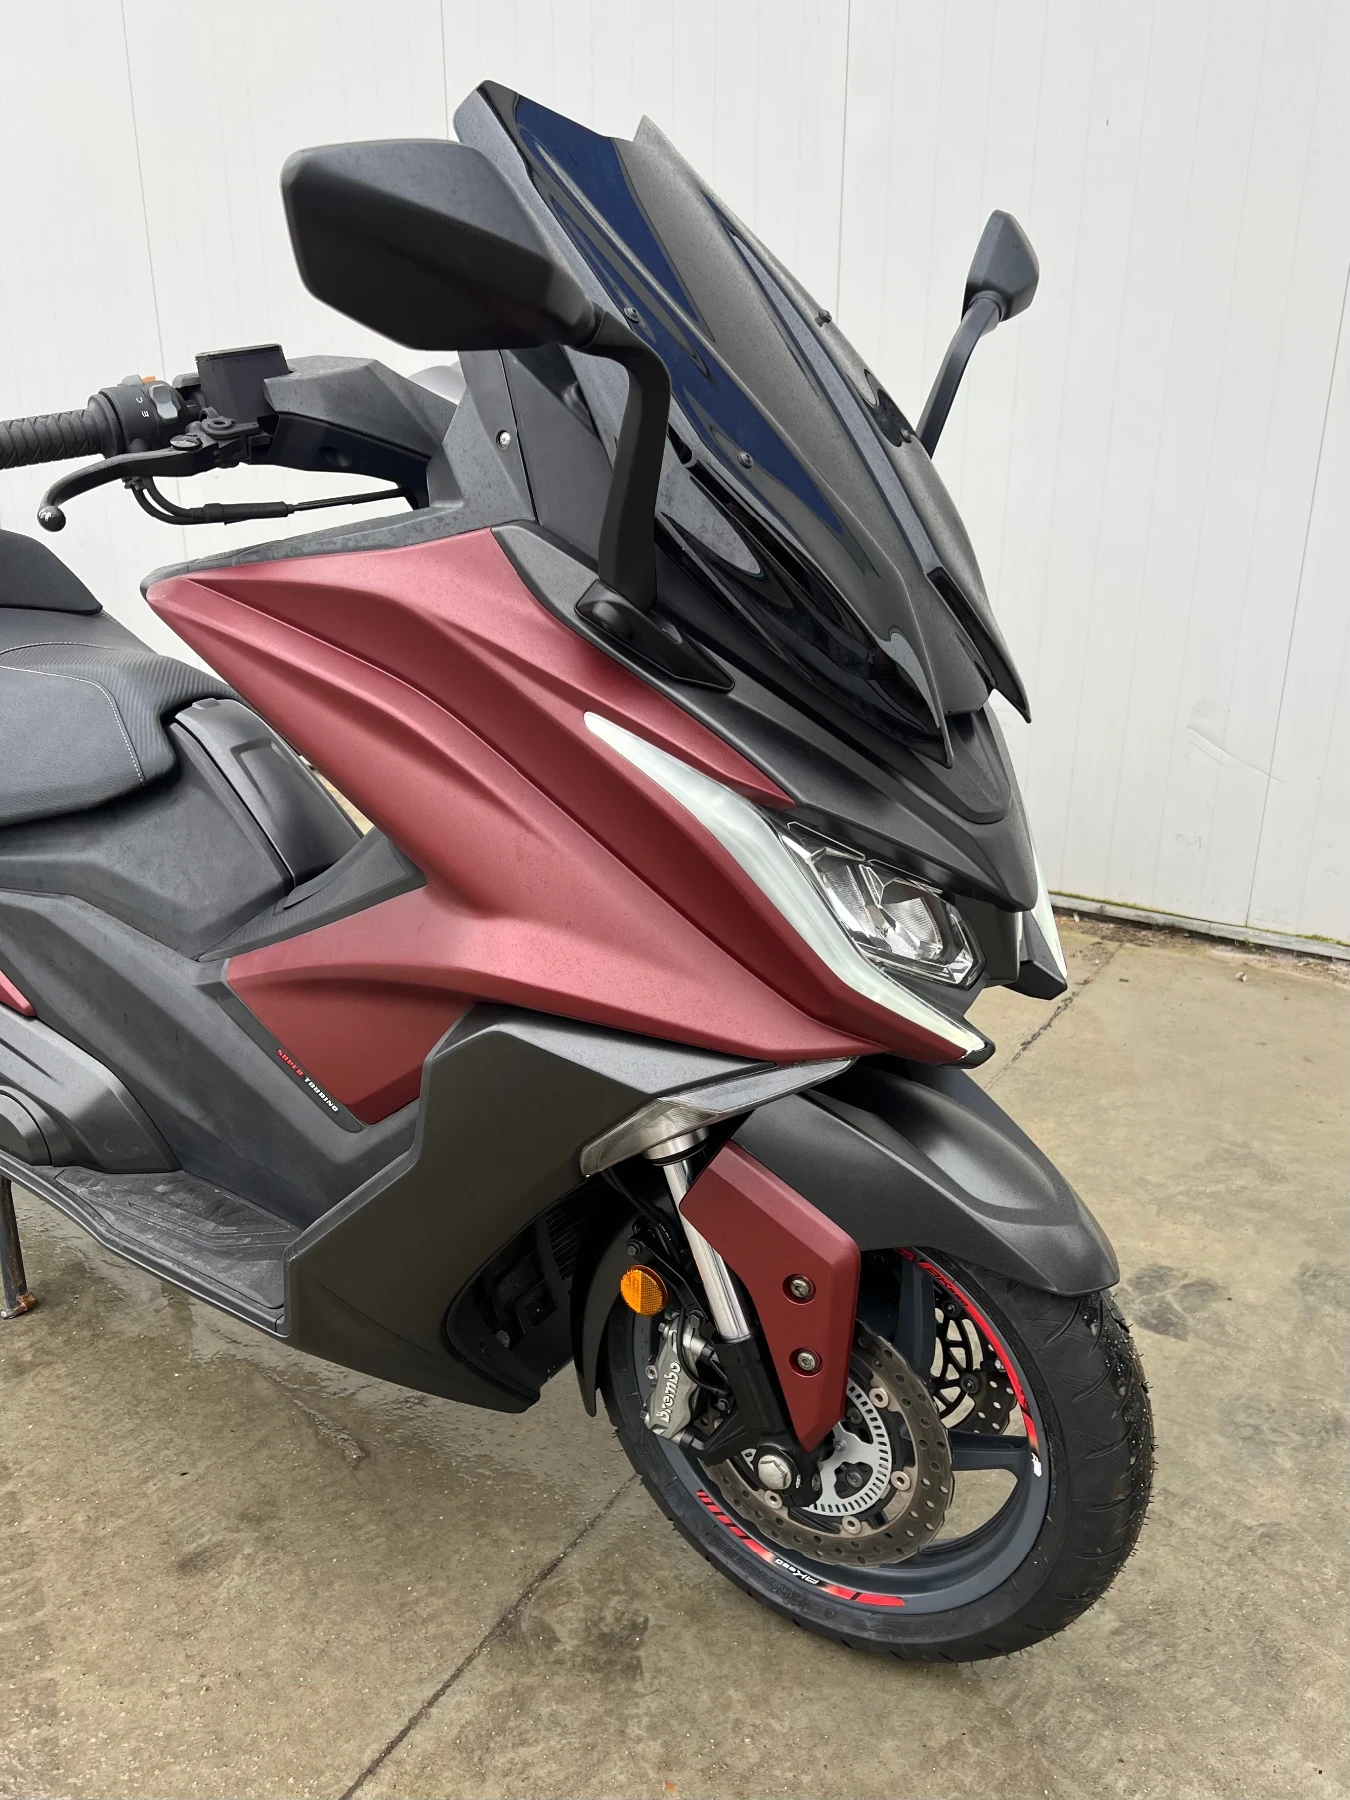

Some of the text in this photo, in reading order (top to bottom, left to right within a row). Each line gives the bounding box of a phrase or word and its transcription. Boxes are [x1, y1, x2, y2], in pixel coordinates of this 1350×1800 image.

[277, 1048, 339, 1112] SUPER TOURING
[656, 1360, 681, 1423] brembo
